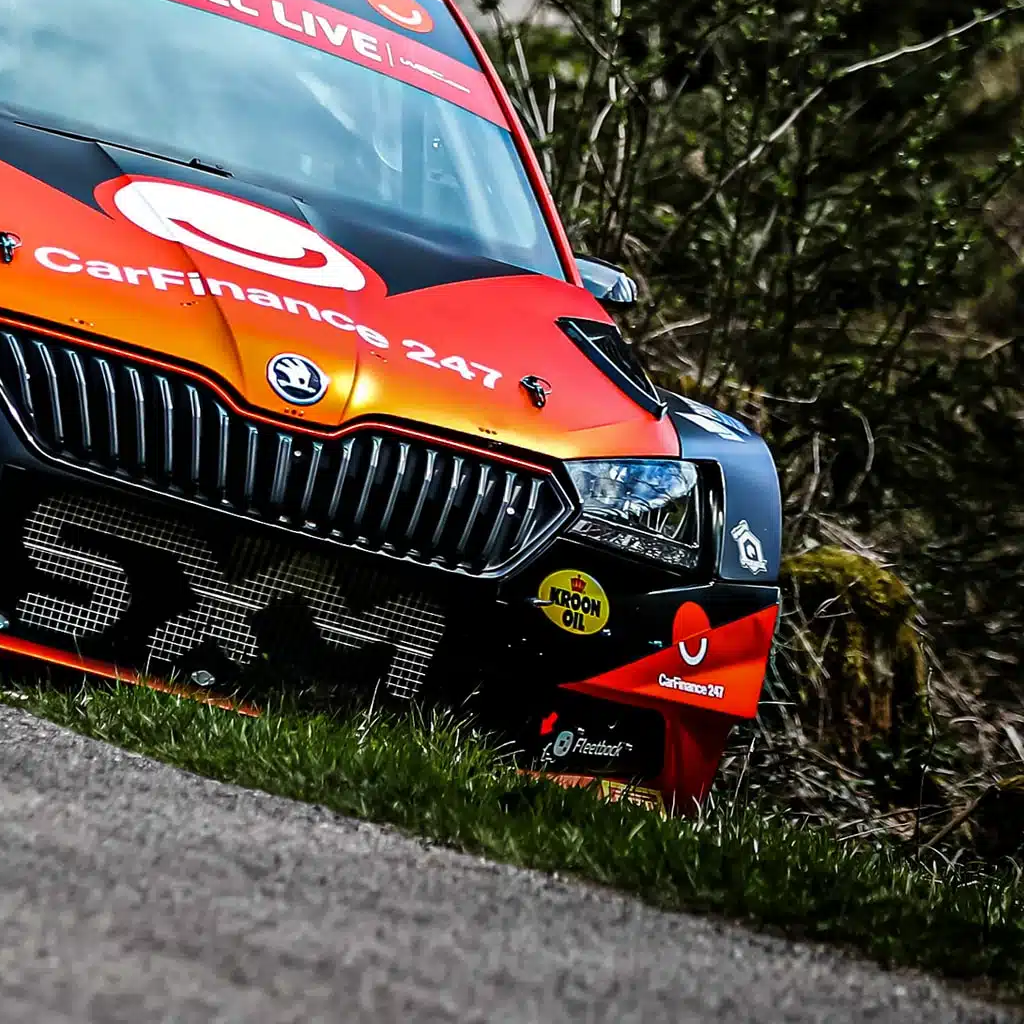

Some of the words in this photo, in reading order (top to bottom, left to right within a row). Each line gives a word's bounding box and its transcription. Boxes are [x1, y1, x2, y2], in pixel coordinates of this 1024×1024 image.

[271, 0, 382, 62] LIVE
[34, 247, 390, 350] CarFinance
[401, 339, 505, 390] 247
[16, 491, 447, 700] SXM
[549, 587, 601, 618] KROON
[562, 609, 585, 632] OIL
[658, 673, 707, 695] CarFinance
[707, 684, 724, 698] 247
[572, 737, 623, 758] Fleetback
